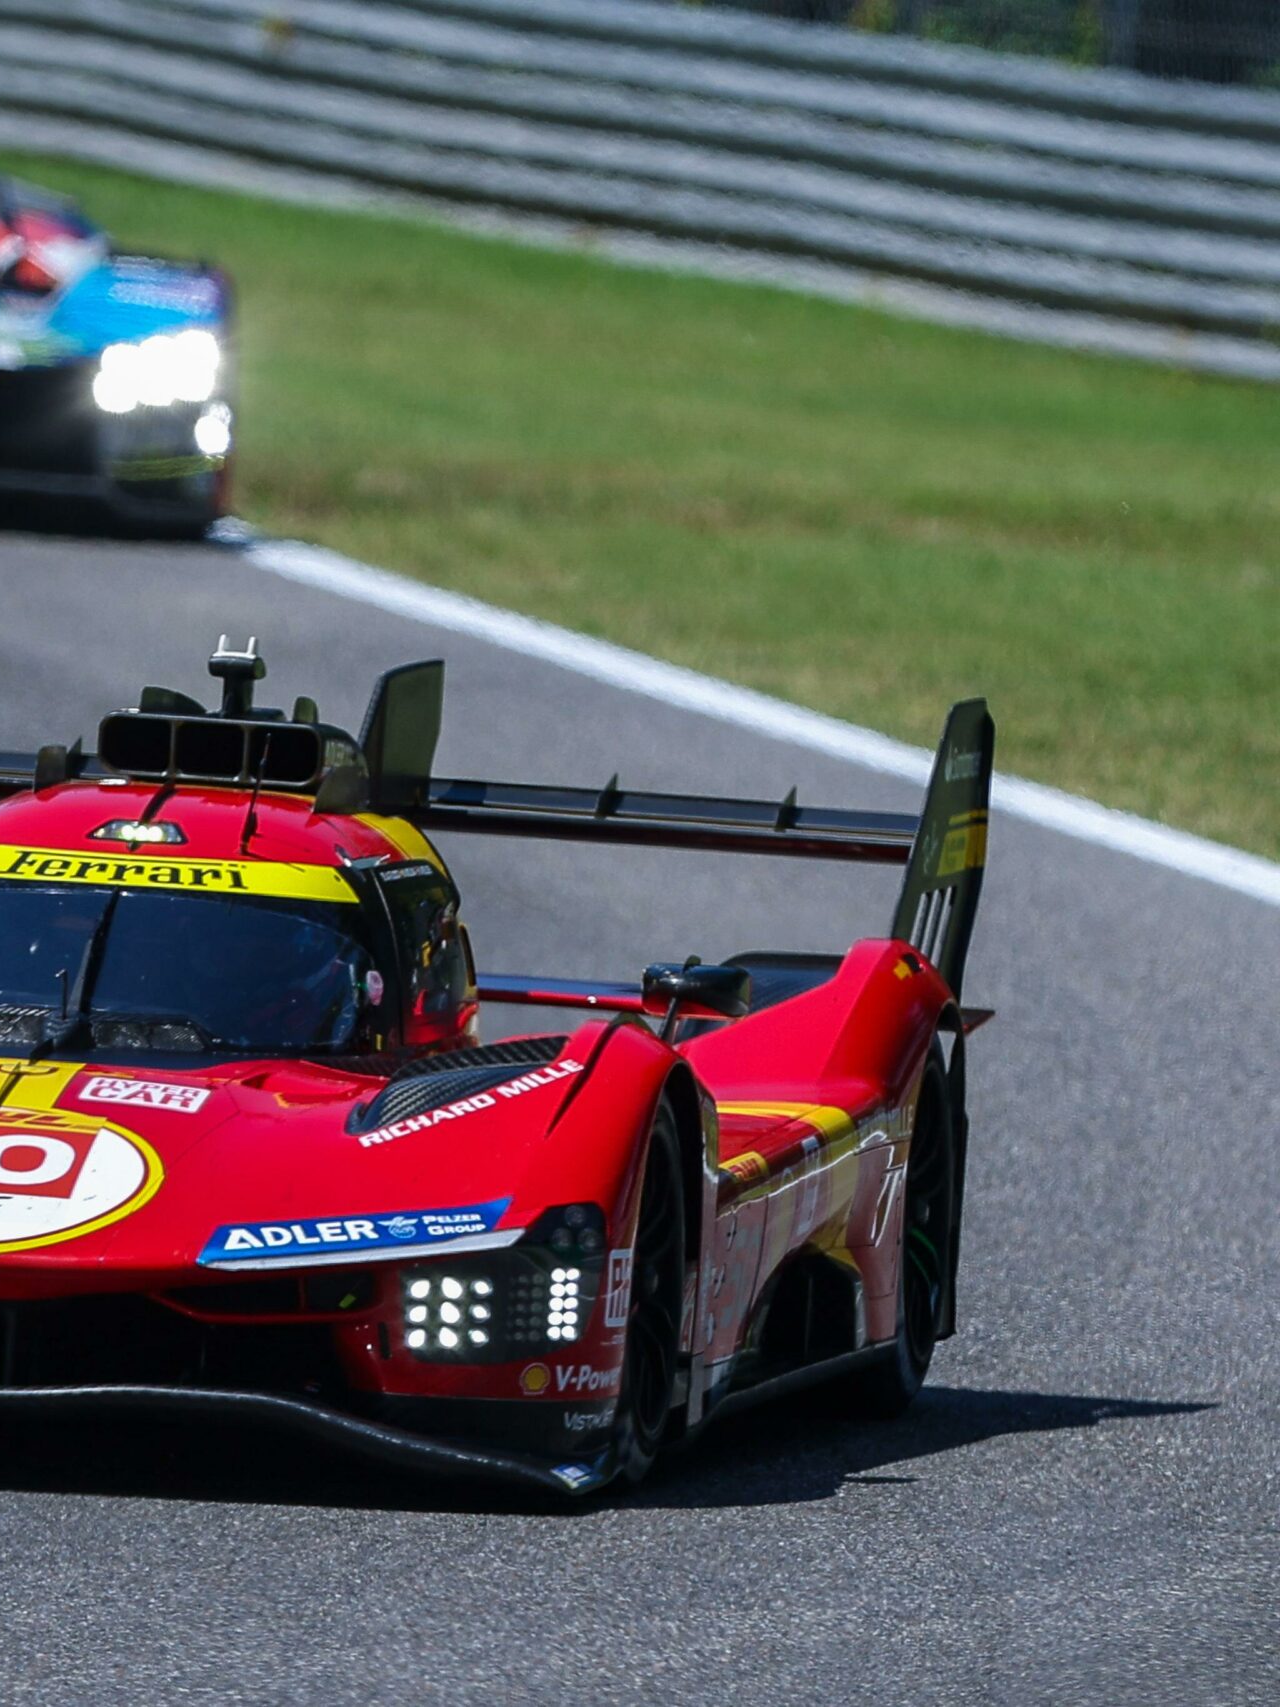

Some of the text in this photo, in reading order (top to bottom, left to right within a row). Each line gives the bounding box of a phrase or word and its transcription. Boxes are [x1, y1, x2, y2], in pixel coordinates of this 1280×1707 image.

[89, 1086, 195, 1109] CAR
[96, 1079, 201, 1097] HYPER
[358, 1058, 585, 1147] RICHARD MILLE
[422, 1214, 482, 1225] PELZER
[427, 1223, 487, 1235] GROUP
[224, 1219, 379, 1250] ADLER
